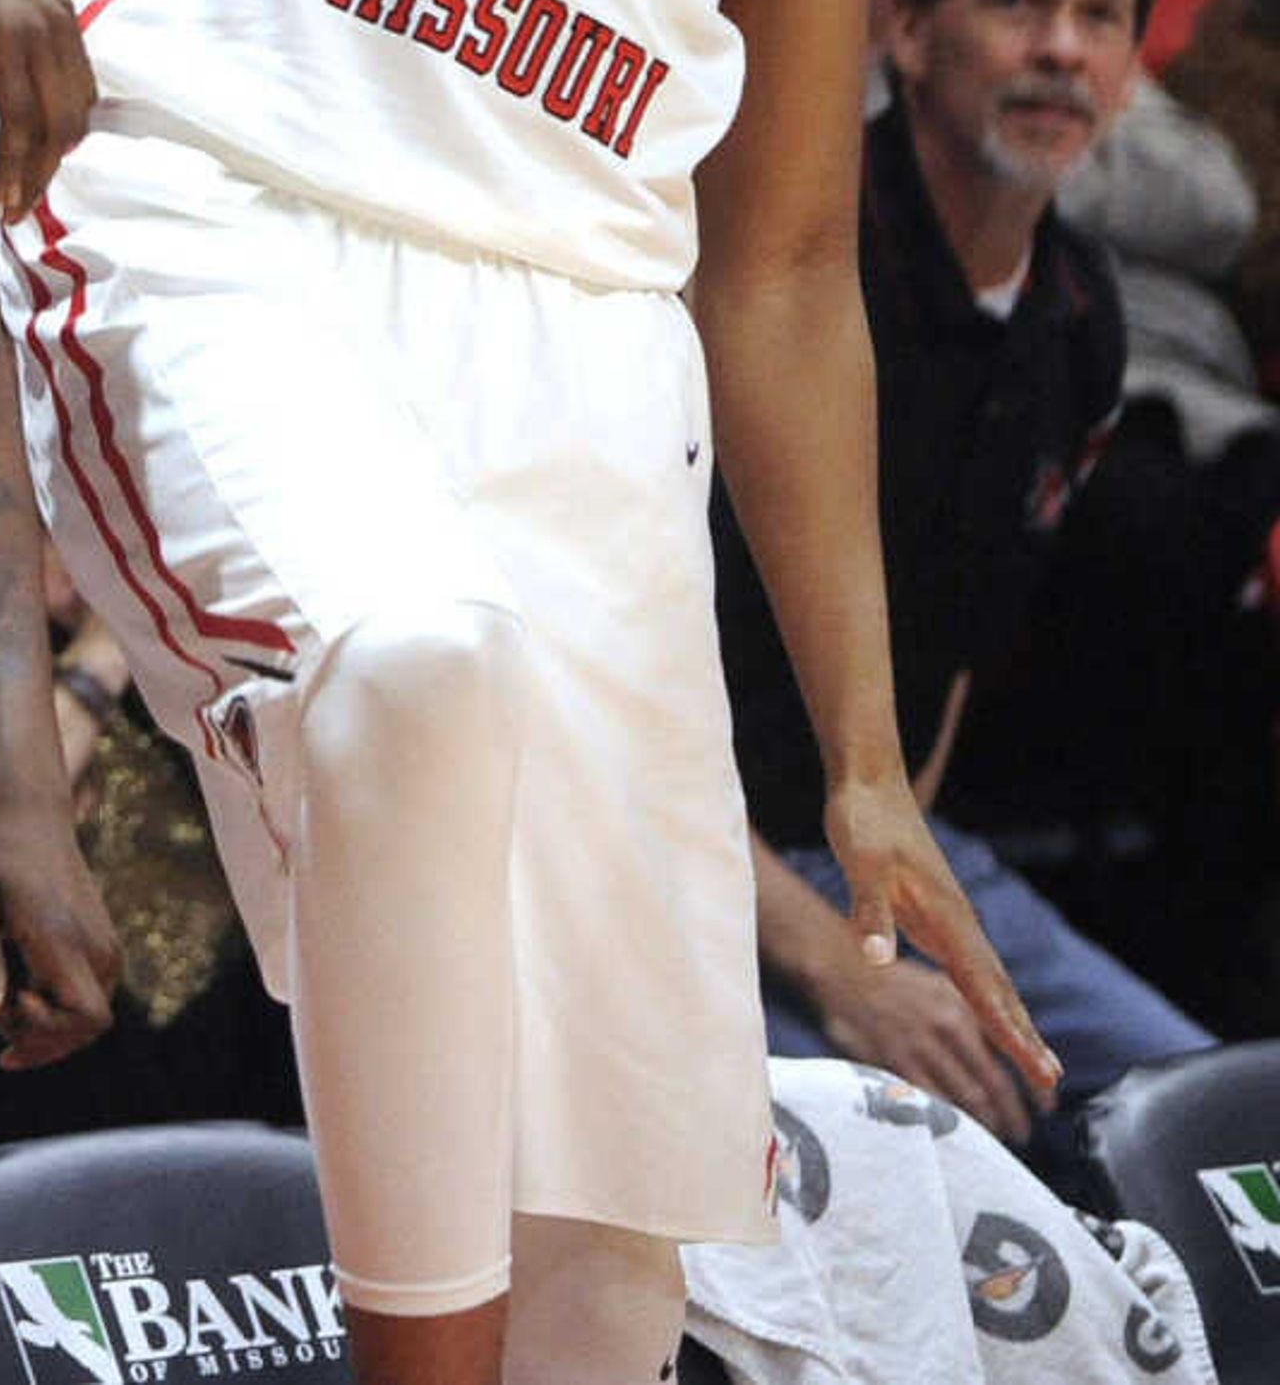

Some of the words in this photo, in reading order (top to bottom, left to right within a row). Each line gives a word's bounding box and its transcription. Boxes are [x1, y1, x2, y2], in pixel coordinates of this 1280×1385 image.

[101, 1264, 347, 1363] BANK
[130, 1360, 169, 1384] OF
[197, 1338, 342, 1377] MISSOU
